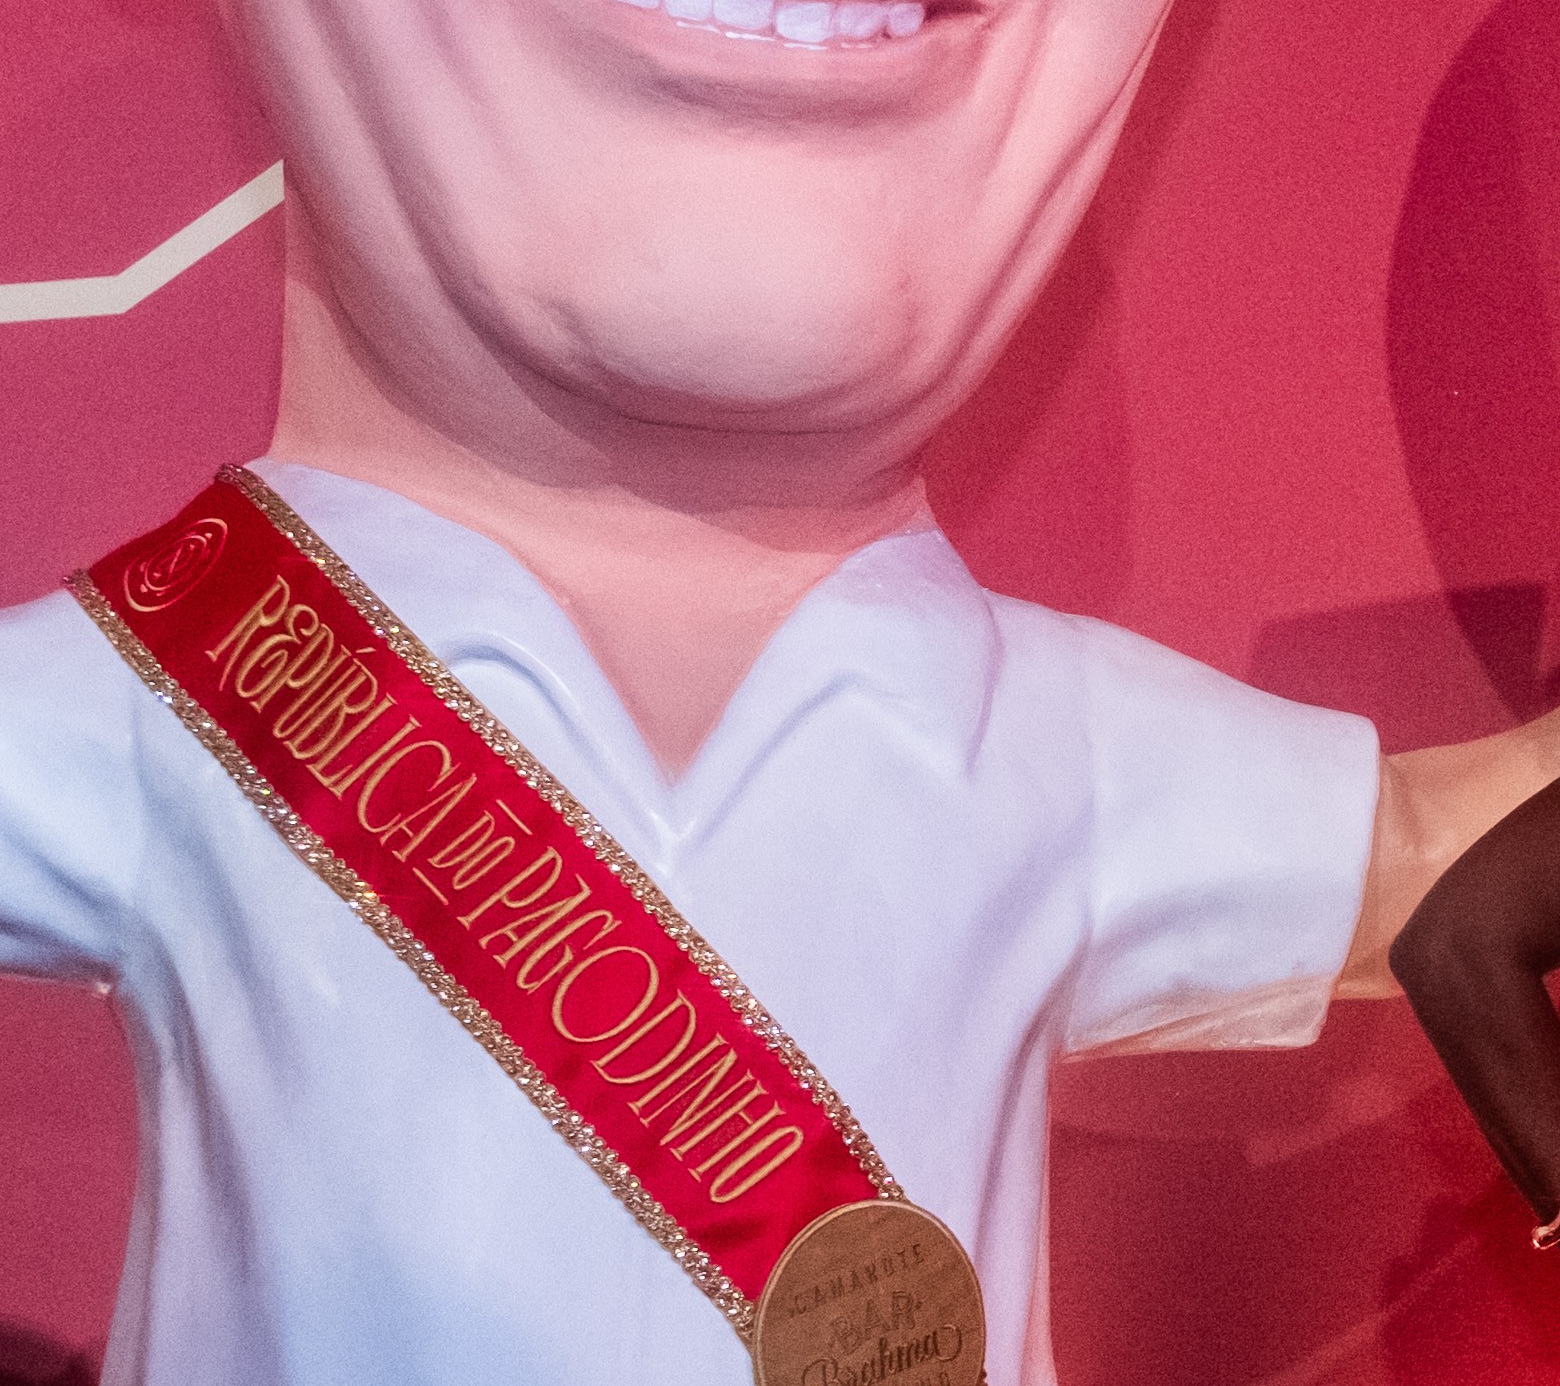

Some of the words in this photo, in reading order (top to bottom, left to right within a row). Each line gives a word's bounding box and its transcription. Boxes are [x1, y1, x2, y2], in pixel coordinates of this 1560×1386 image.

[206, 574, 477, 862] REPÚBLICA
[427, 809, 517, 892] DO
[456, 845, 804, 1205] PAGODINHO
[793, 1242, 929, 1317] CAMAROTE
[828, 1289, 918, 1356] BAR
